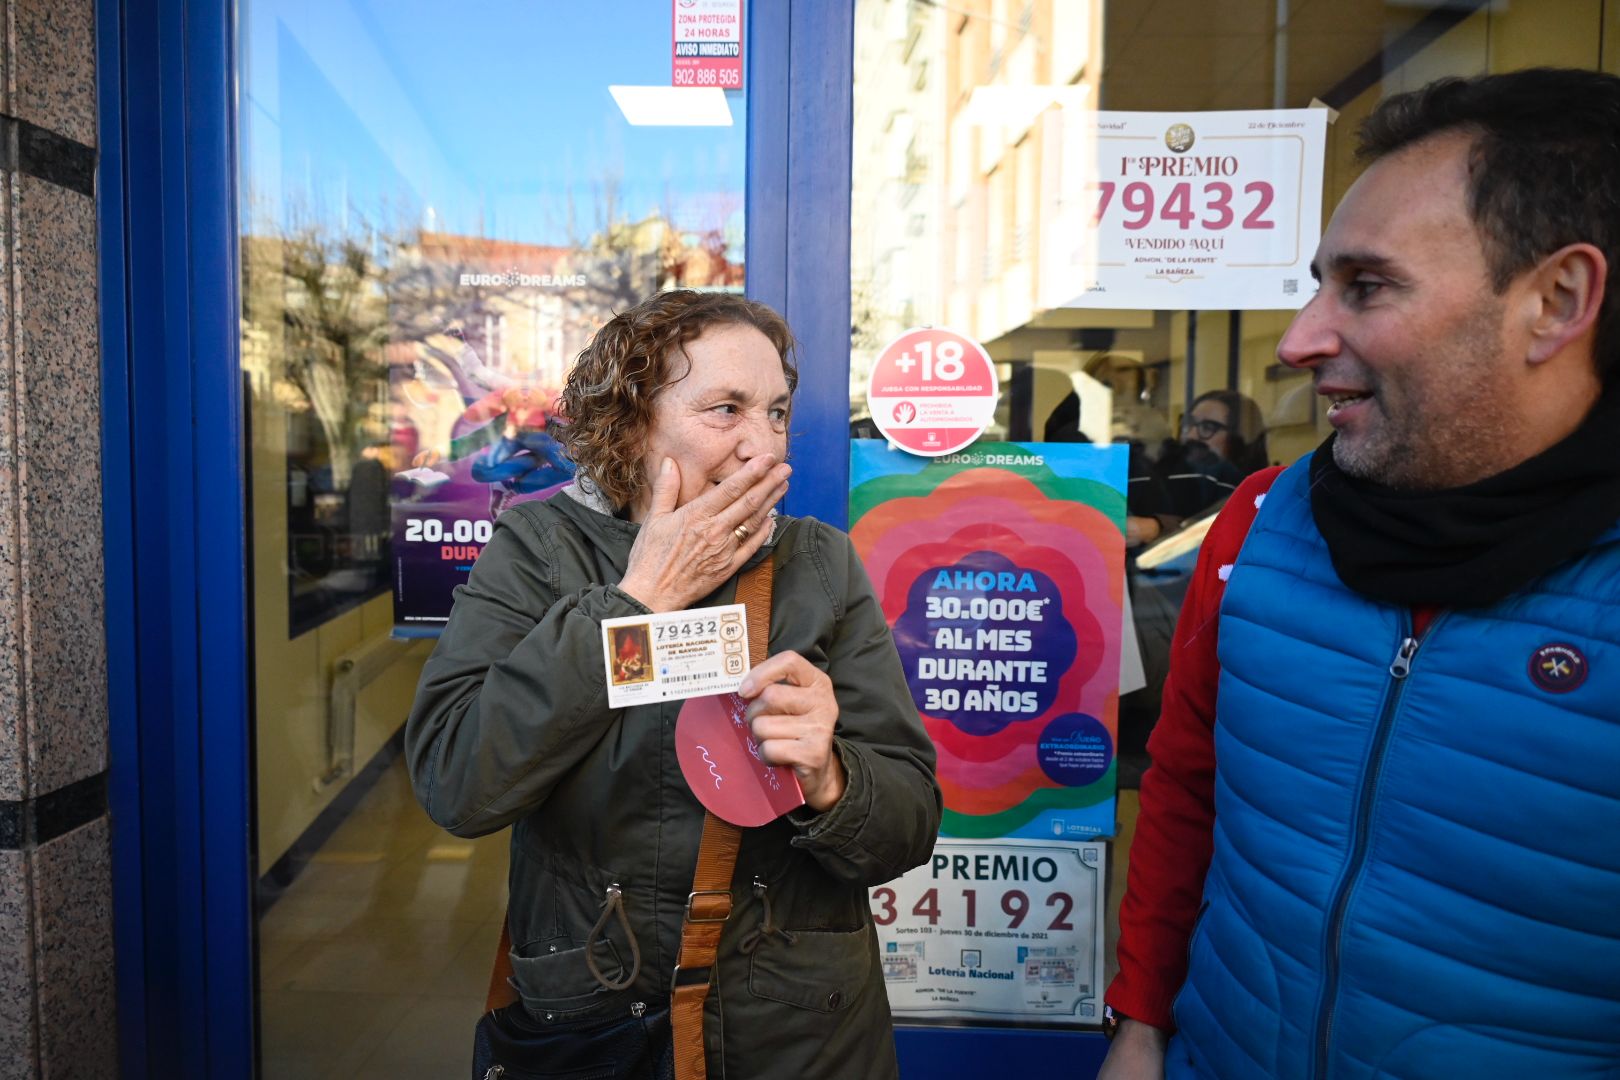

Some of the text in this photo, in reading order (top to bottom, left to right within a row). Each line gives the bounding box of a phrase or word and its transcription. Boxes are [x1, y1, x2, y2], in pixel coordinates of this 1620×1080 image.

[679, 14, 737, 24] ZONA PROTEGIDA
[684, 28, 731, 38] 24 HORAS
[676, 43, 739, 56] AVISO INMEDIATO
[675, 69, 739, 85] 902 886 505
[1138, 156, 1238, 177] PREMIO
[1083, 181, 1275, 230] 79432
[1125, 235, 1224, 252] VENDIDO AQUÍ
[460, 274, 586, 287] EURO DREAMS
[895, 340, 965, 382] +18
[986, 454, 1044, 466] DREAMS
[932, 569, 1038, 592] AHORA
[656, 621, 717, 639] 79432
[935, 627, 1032, 652] AL MES
[918, 657, 1048, 683] DURANTE
[925, 684, 1038, 713] 30 AÑOS
[932, 854, 1058, 883] PREMIO
[871, 887, 1074, 931] 34192
[969, 968, 1014, 980] Nacional
